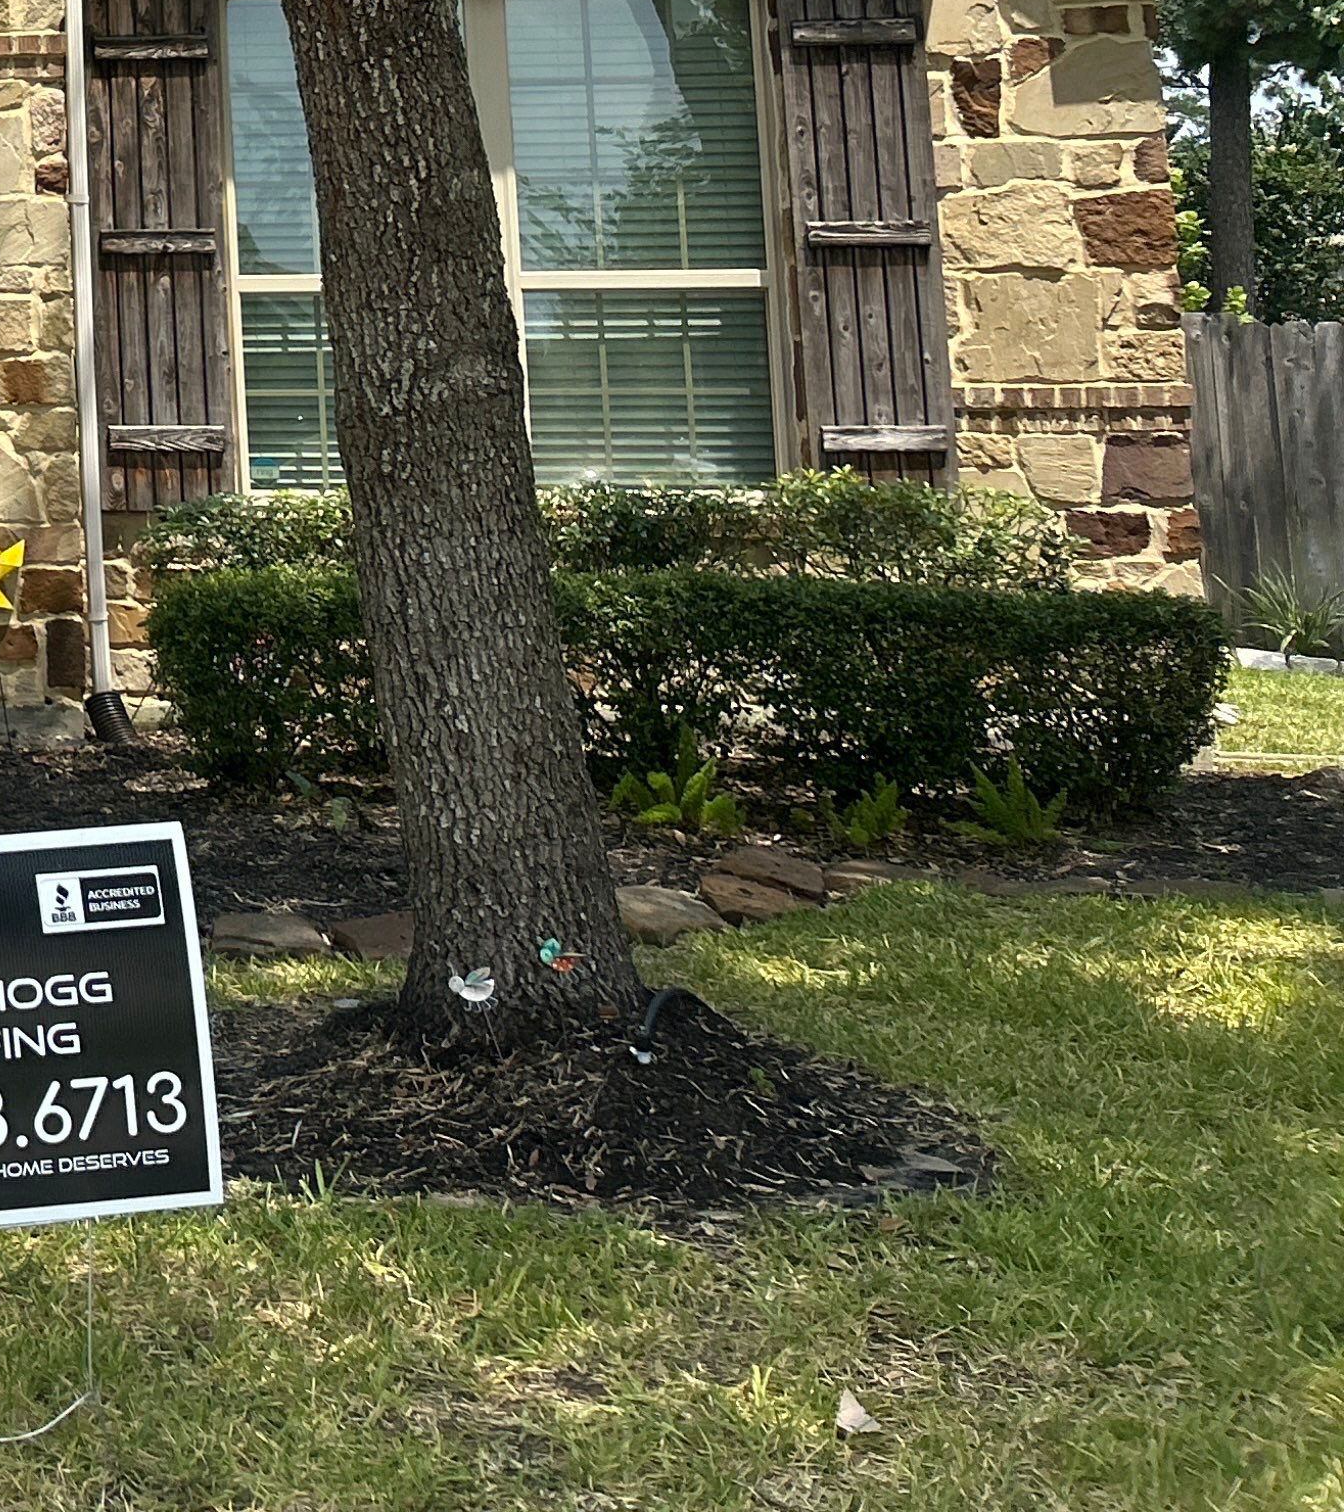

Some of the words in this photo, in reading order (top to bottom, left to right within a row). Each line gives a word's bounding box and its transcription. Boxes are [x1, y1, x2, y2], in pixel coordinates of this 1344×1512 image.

[87, 885, 155, 900] ACCREDITED
[88, 899, 141, 912] BUSINESS
[51, 911, 77, 923] BBB
[58, 1148, 170, 1173] DESERVES
